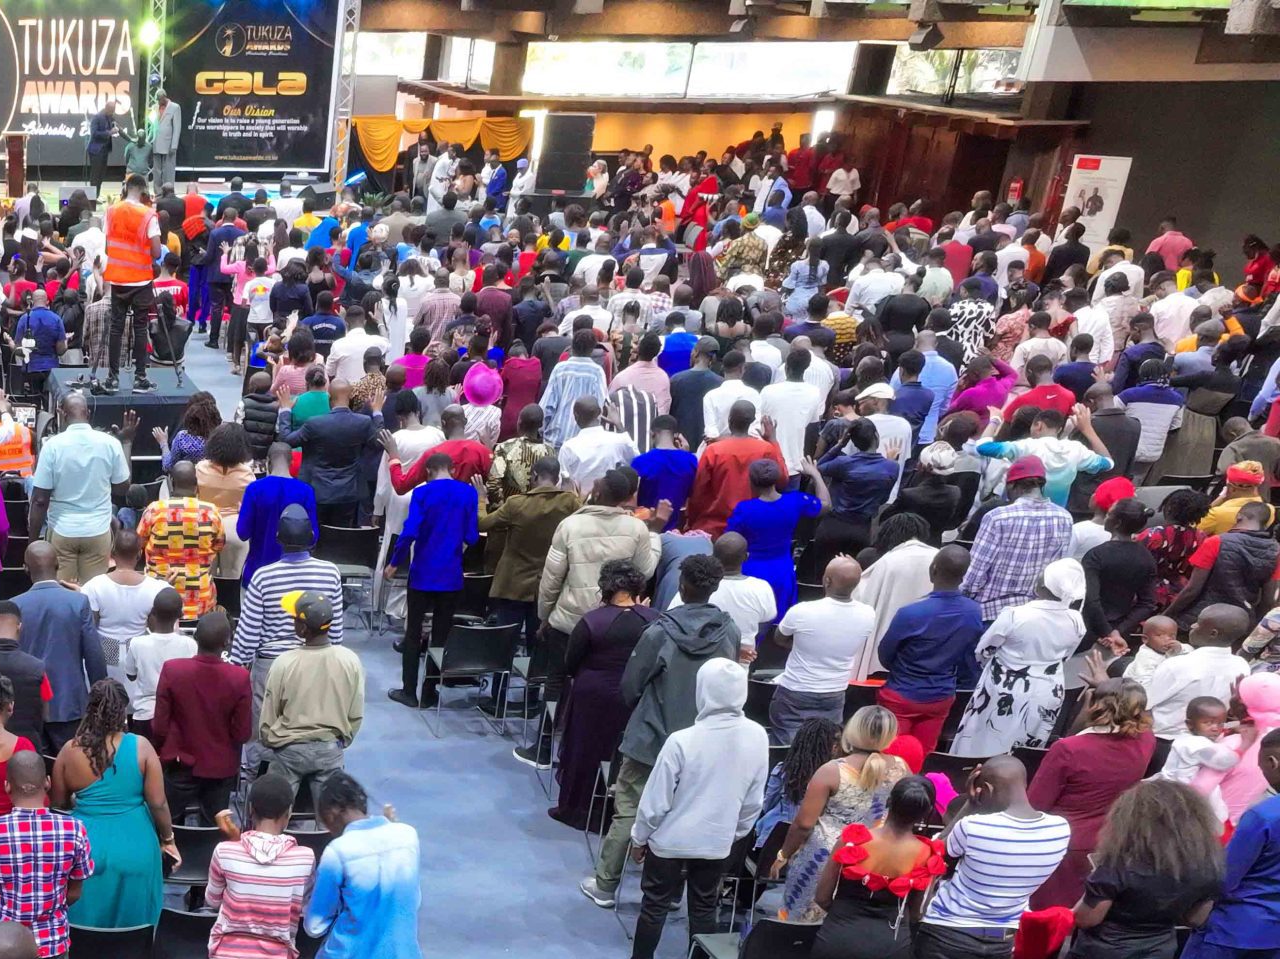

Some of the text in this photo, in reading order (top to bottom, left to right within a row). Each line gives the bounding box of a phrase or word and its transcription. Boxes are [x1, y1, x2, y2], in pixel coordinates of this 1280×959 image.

[246, 25, 293, 41] TUKUZA
[18, 18, 135, 76] TUKUZA
[20, 80, 132, 115] AWARDS
[222, 105, 276, 117] Our Vision
